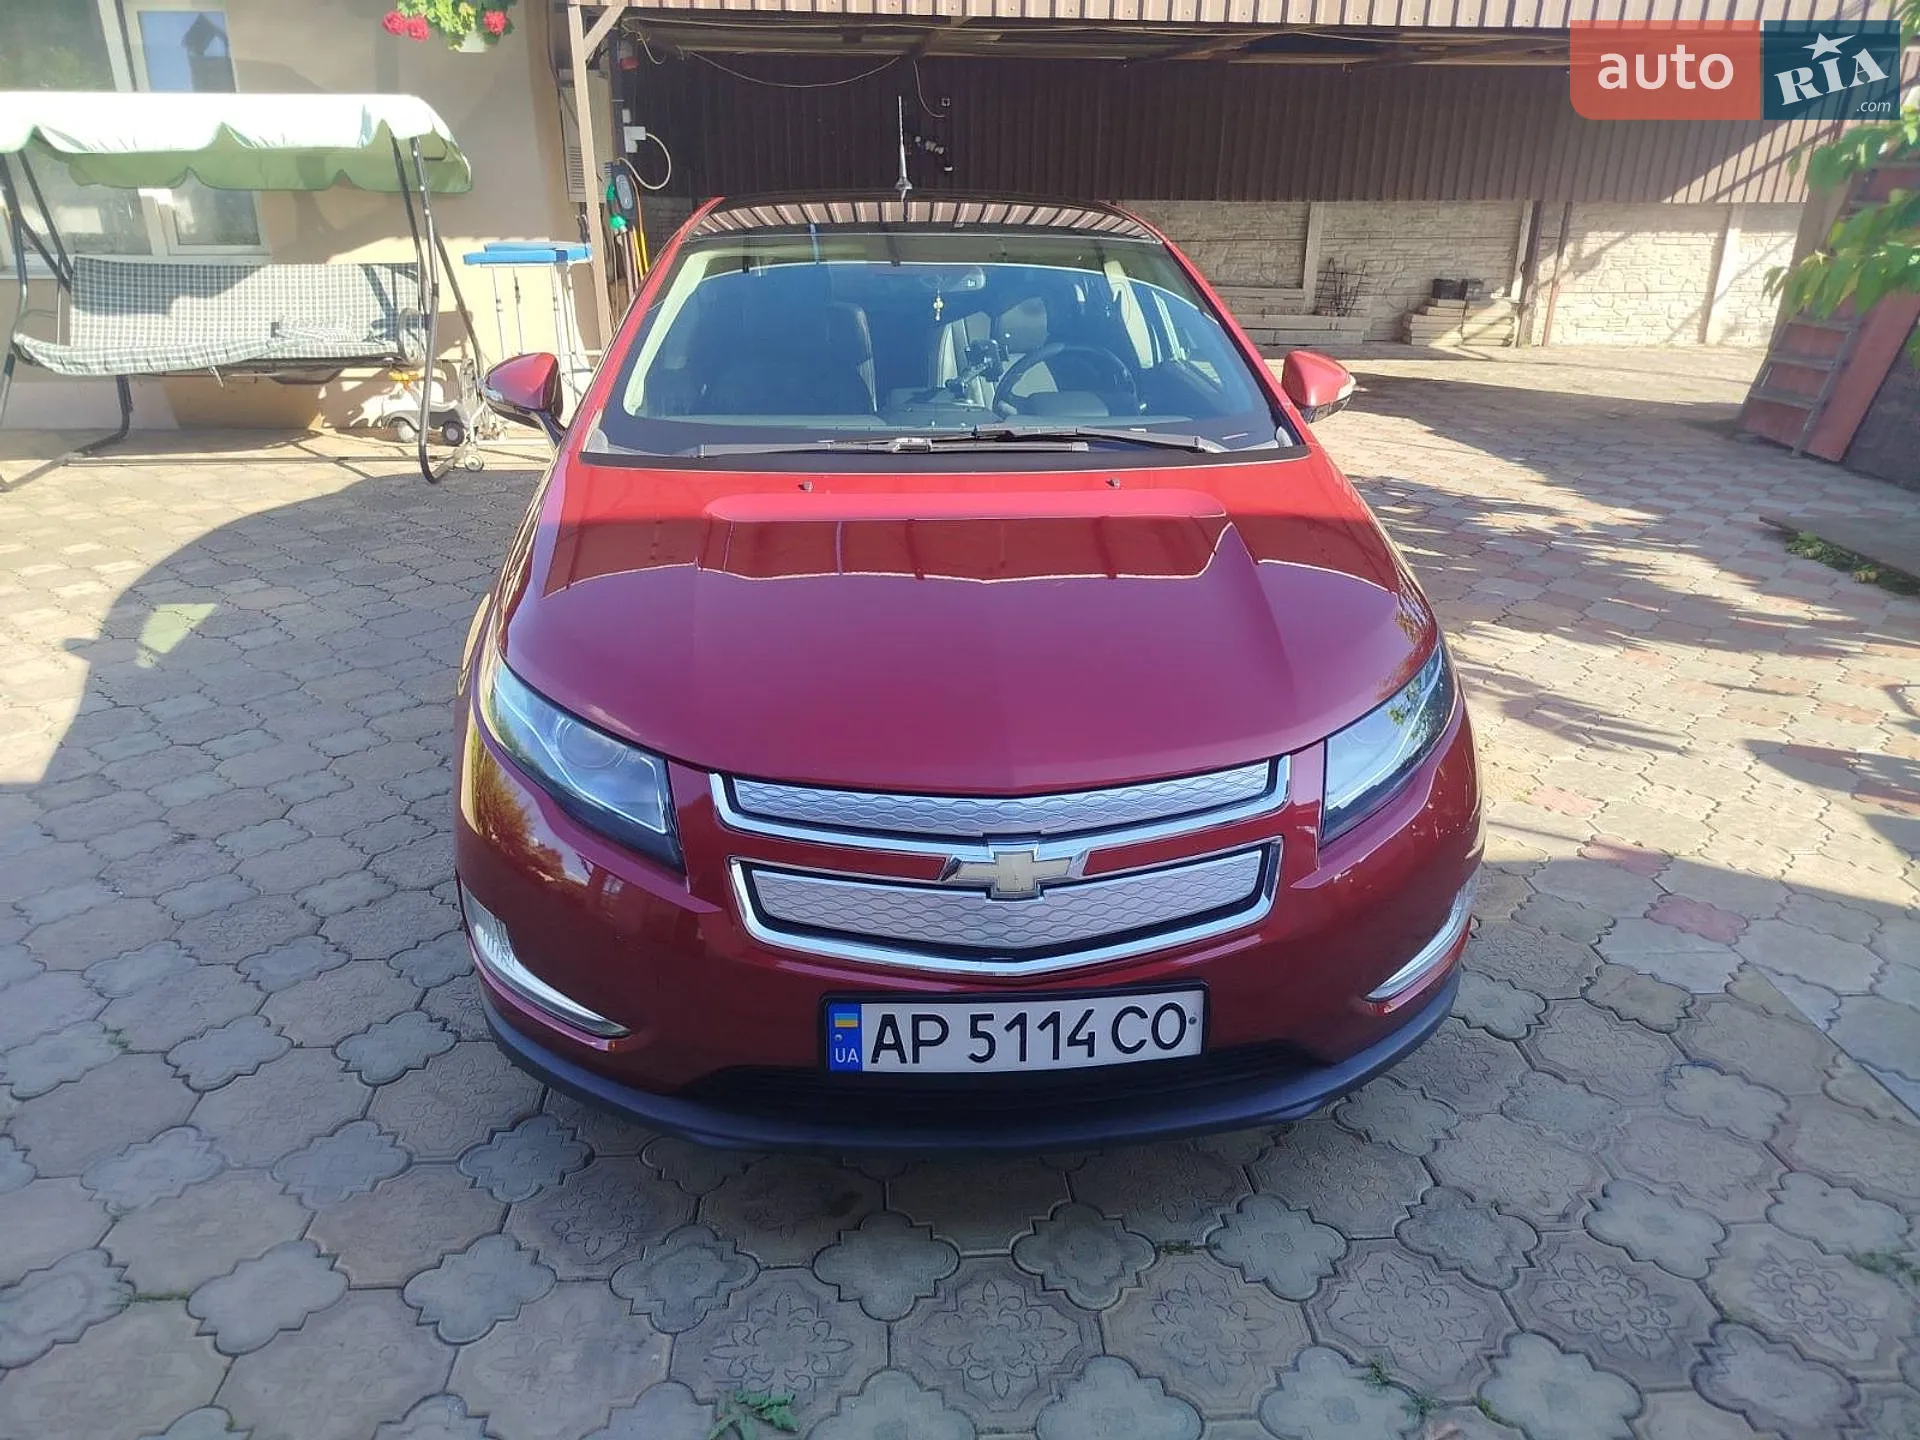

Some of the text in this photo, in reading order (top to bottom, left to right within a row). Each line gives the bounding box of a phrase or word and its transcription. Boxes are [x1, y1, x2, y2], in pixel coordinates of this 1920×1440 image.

[870, 1001, 1187, 1065] AP 5114 CO
[834, 1047, 859, 1064] UA
